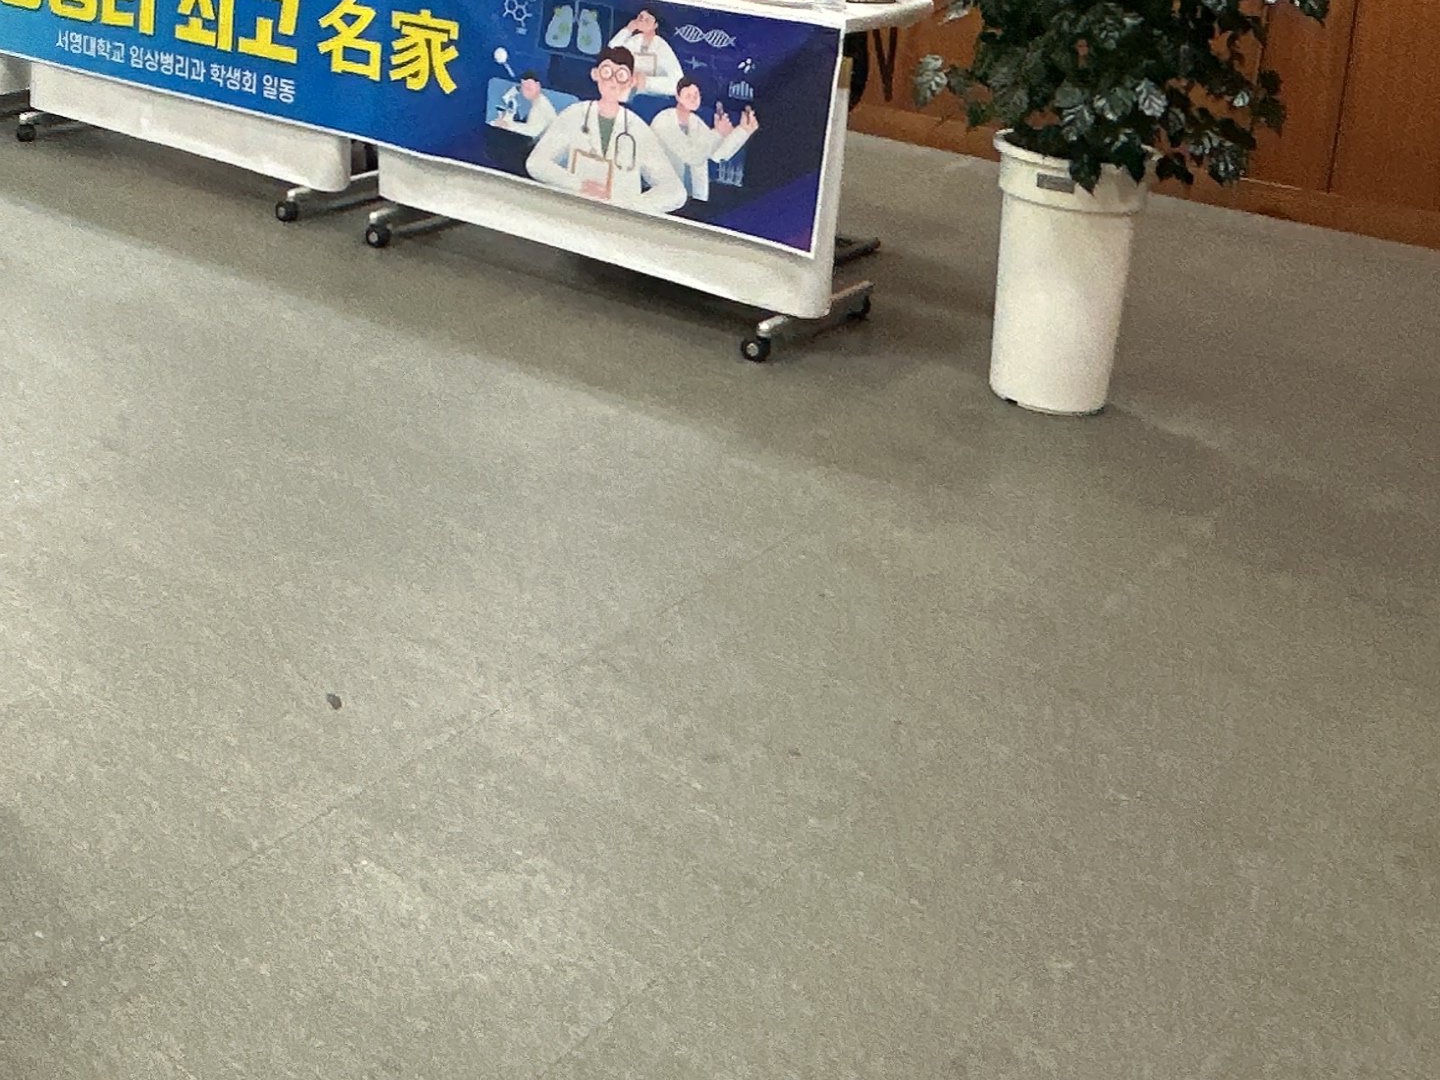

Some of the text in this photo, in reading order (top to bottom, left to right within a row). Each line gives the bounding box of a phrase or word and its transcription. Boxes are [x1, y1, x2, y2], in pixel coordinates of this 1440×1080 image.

[55, 30, 296, 105] 서영대학교 임상병리과 학생회 일동
